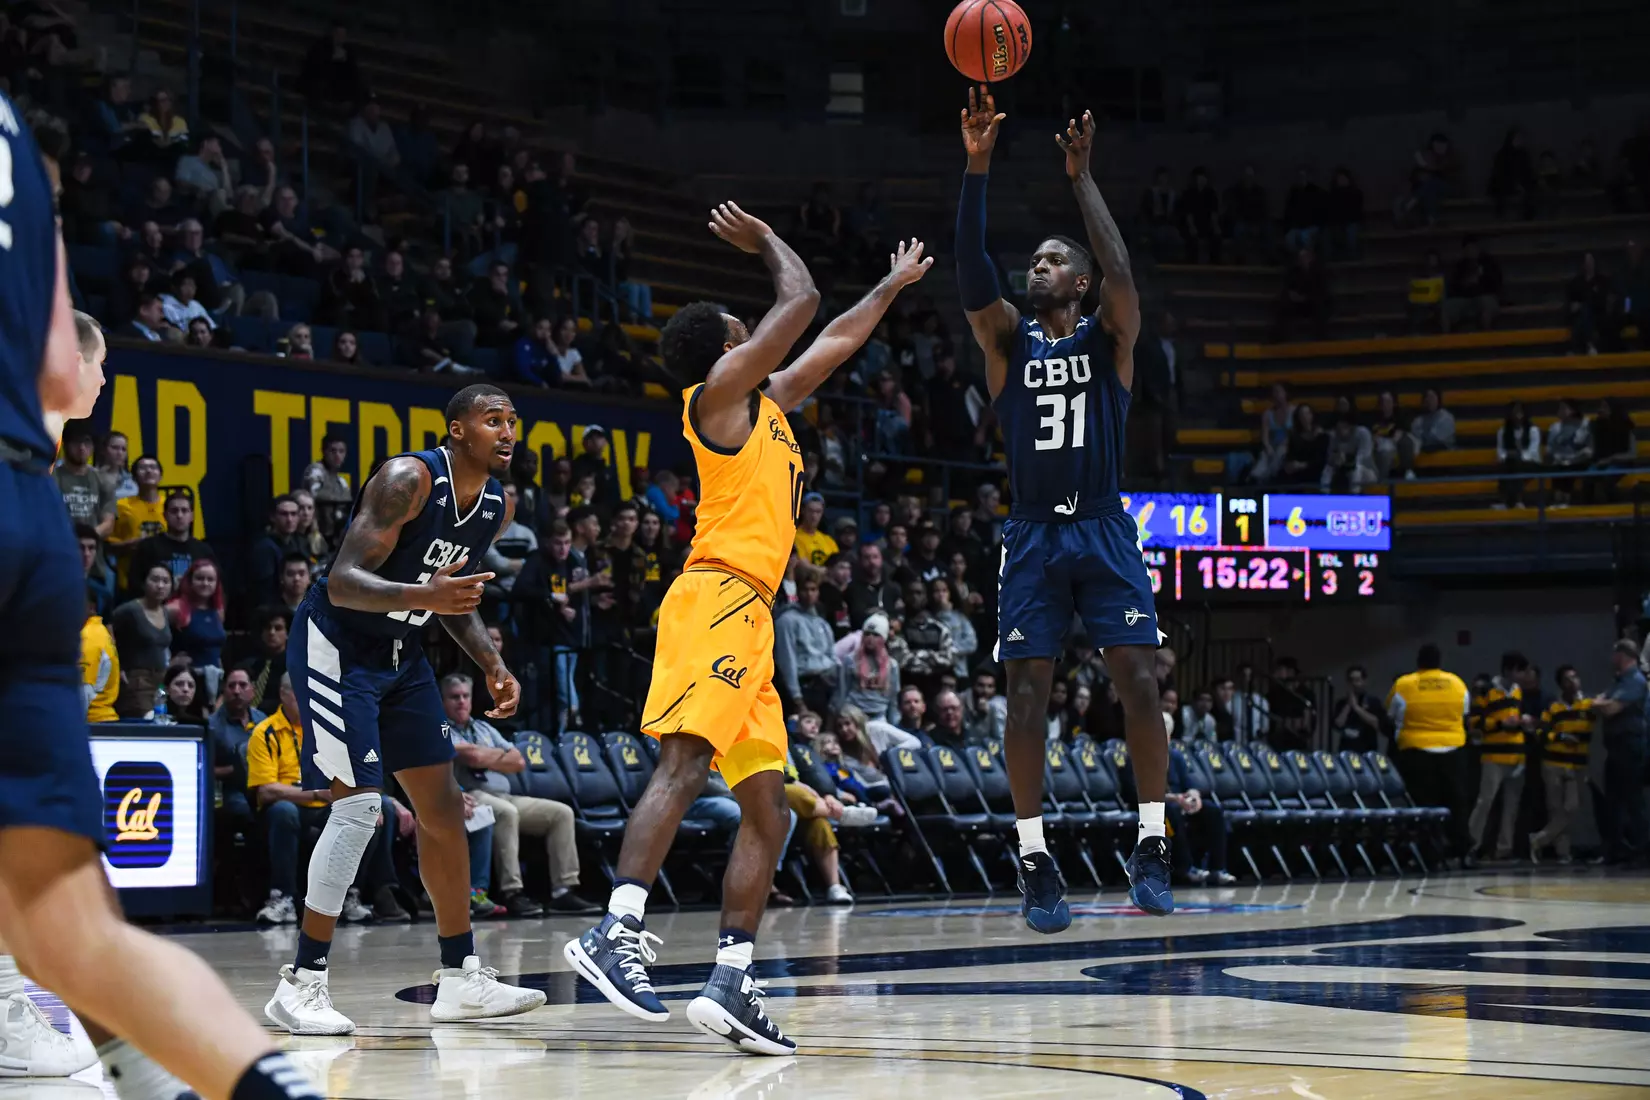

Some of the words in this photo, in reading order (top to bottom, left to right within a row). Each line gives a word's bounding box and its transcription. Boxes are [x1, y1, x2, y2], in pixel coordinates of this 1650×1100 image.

[993, 24, 1008, 76] Wilson
[1024, 354, 1092, 388] CBU
[1035, 391, 1086, 451] 31
[110, 373, 207, 541] AR
[1169, 504, 1208, 536] 16
[1228, 498, 1257, 513] PER
[1286, 506, 1306, 537] 6
[1234, 514, 1249, 542] 1
[1326, 510, 1383, 536] CBU
[423, 538, 471, 569] CBU
[1198, 556, 1289, 590] 15:22
[1321, 570, 1338, 595] 3
[1357, 570, 1374, 595] 2
[709, 655, 748, 689] Cal
[115, 787, 161, 841] Cal
